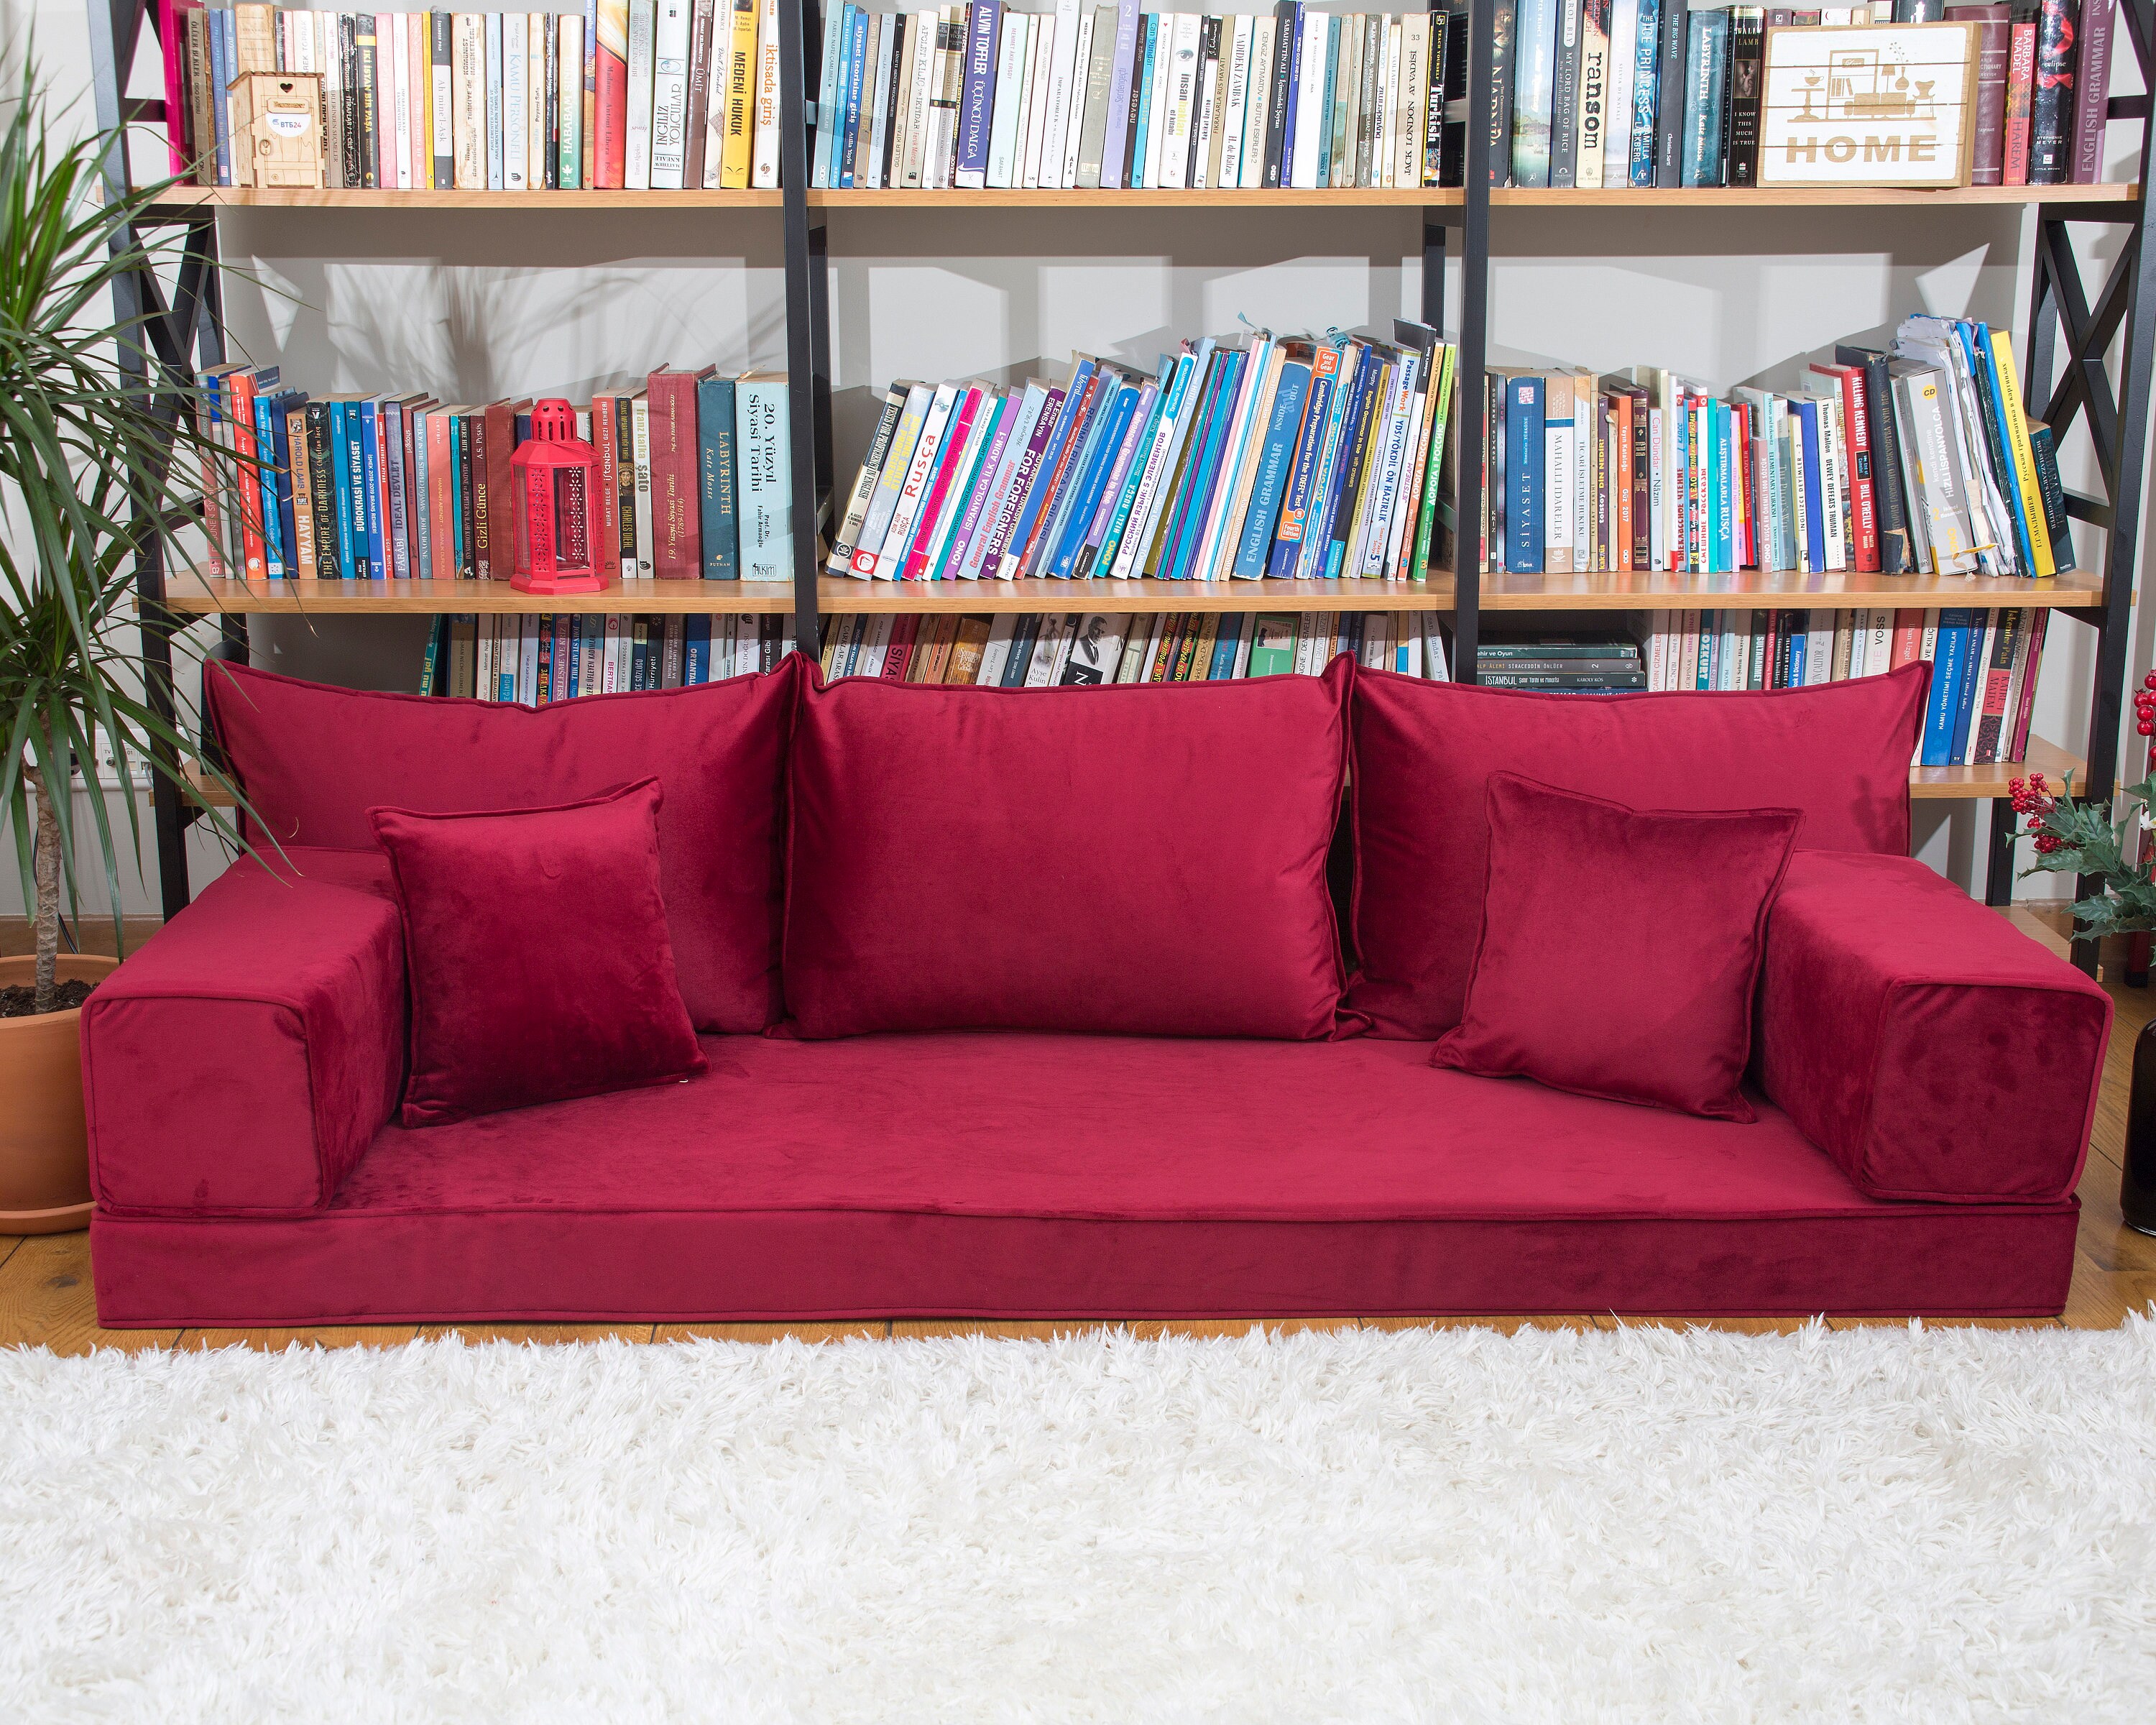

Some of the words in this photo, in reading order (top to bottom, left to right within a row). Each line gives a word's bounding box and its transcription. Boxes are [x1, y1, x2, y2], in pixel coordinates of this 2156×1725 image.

[978, 6, 992, 34] ALVIN
[1641, 24, 1653, 44] ICE
[733, 52, 747, 94] MEDENİ
[764, 44, 778, 93] iktisada
[827, 55, 836, 82] ÇAMLIBEL
[974, 37, 990, 75] TOFFLER
[1565, 52, 1572, 65] MY
[1699, 27, 1712, 100] LABYRINTH
[2012, 37, 2023, 74] NADEL
[2020, 29, 2032, 81] BARBARA
[2045, 60, 2067, 68] eclipse
[2088, 27, 2106, 104] GRAMMAR
[1409, 83, 1415, 96] AY
[1637, 49, 1652, 114] PRINCESS
[670, 83, 682, 146] YOLCULAR
[730, 98, 743, 136] HUKUK
[760, 97, 773, 126] giriş
[970, 80, 986, 124] ÜÇÜNCÜ
[1213, 96, 1222, 134] FIKRALARLA
[1427, 84, 1444, 142] Turkish
[1584, 52, 1603, 150] ransom
[967, 124, 979, 159] DALGA
[1406, 101, 1415, 146] LONDON
[1562, 117, 1569, 130] OF
[1698, 114, 1708, 135] Kate
[2081, 108, 2099, 172] ENGLISH
[1641, 124, 1650, 160] CAMILLA
[1697, 137, 1706, 162] Mosse
[1785, 134, 1937, 164] HOME
[2010, 121, 2022, 169] HAREM
[1320, 363, 1333, 372] Gear
[1322, 351, 1336, 361] Gear
[1924, 387, 1935, 397] CD
[2001, 362, 2014, 402] картинках
[636, 408, 646, 431] franz
[748, 394, 760, 441] Siyasî
[764, 403, 775, 430] 20.
[1653, 416, 1662, 433] Can
[2010, 409, 2024, 454] грамматика
[294, 436, 303, 466] HAROLD
[637, 433, 647, 459] kafka
[763, 435, 777, 483] Yüzyıl
[1018, 448, 1036, 475] FOR
[1653, 433, 1662, 470] Dündar
[635, 464, 650, 492] şato
[719, 431, 731, 515] LABYRINTH
[750, 445, 762, 492] Tarihi
[904, 435, 936, 497] Rusça
[1245, 507, 1268, 563] ENGLISH
[1259, 441, 1284, 505] GRAMMAR
[1274, 403, 1287, 431] INSIDE
[1402, 462, 1414, 504] JETSTREAM
[2018, 454, 2030, 483] Русская
[317, 469, 329, 511] DARKNESS
[475, 483, 487, 519] Günce
[1122, 520, 1138, 556] РУССКИЙ
[1133, 488, 1148, 519] ЯЗЫК:
[1146, 432, 1166, 480] ЭЛЕМЕНТОВ
[1652, 479, 1661, 507] Nâzım
[320, 513, 329, 523] OF
[621, 506, 633, 532] CHARLES
[969, 531, 987, 569] General
[982, 500, 1000, 533] English
[994, 460, 1015, 502] Grammar
[987, 476, 1025, 556] FOREIGNERS
[1284, 523, 1300, 532] Fourth
[298, 515, 313, 564] HAYYAM
[321, 525, 332, 556] EMPIRE
[476, 522, 489, 549] Gizli
[622, 533, 634, 549] DIEHL
[323, 560, 334, 575] THE
[1302, 612, 1312, 651] DENEMELER
[1430, 633, 1439, 660] dündar
[1874, 615, 1886, 645] VOSS
[1697, 627, 1710, 679] BOZKURT
[1753, 636, 1765, 684] SULTANAHMET
[1999, 648, 2009, 665] Pala
[648, 655, 657, 691] Hürriyeti
[1028, 674, 1046, 685] Kulin
[1031, 666, 1048, 678] Ayşe
[1986, 676, 1999, 709] MATEM
